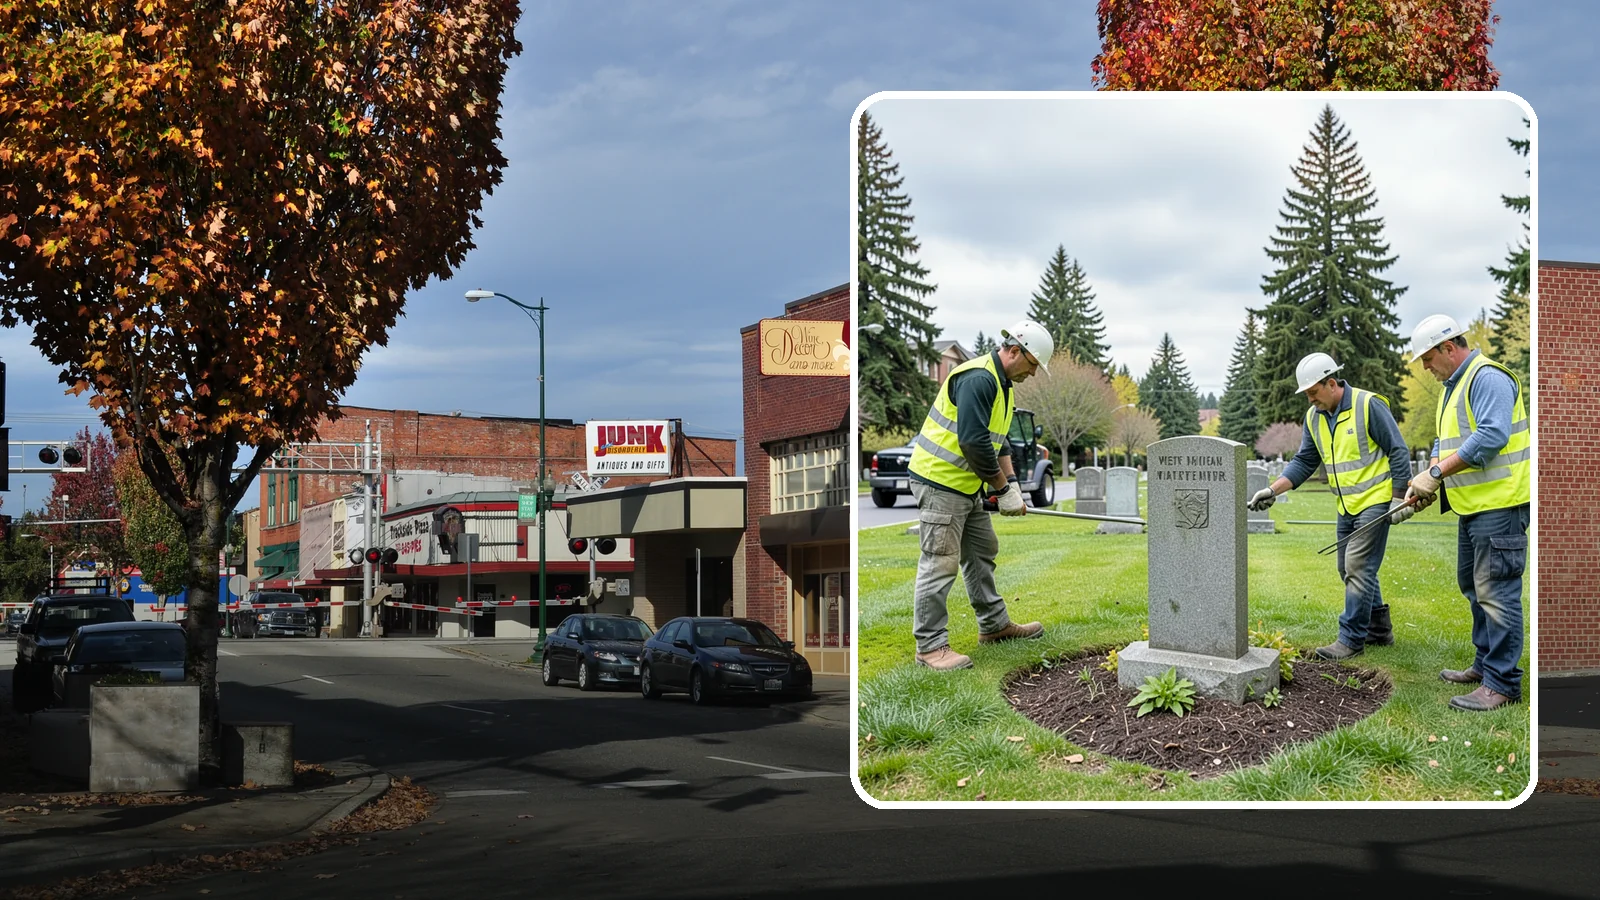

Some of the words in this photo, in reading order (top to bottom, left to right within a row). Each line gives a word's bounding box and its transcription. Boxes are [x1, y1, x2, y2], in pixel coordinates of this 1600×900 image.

[596, 425, 665, 457] JUNK
[607, 446, 646, 454] DISORDERLY
[597, 461, 628, 470] ANTIQUES
[631, 461, 644, 470] AND
[647, 461, 666, 470] GIFTS
[390, 521, 413, 540] Trackside
[414, 519, 429, 534] Pizza
